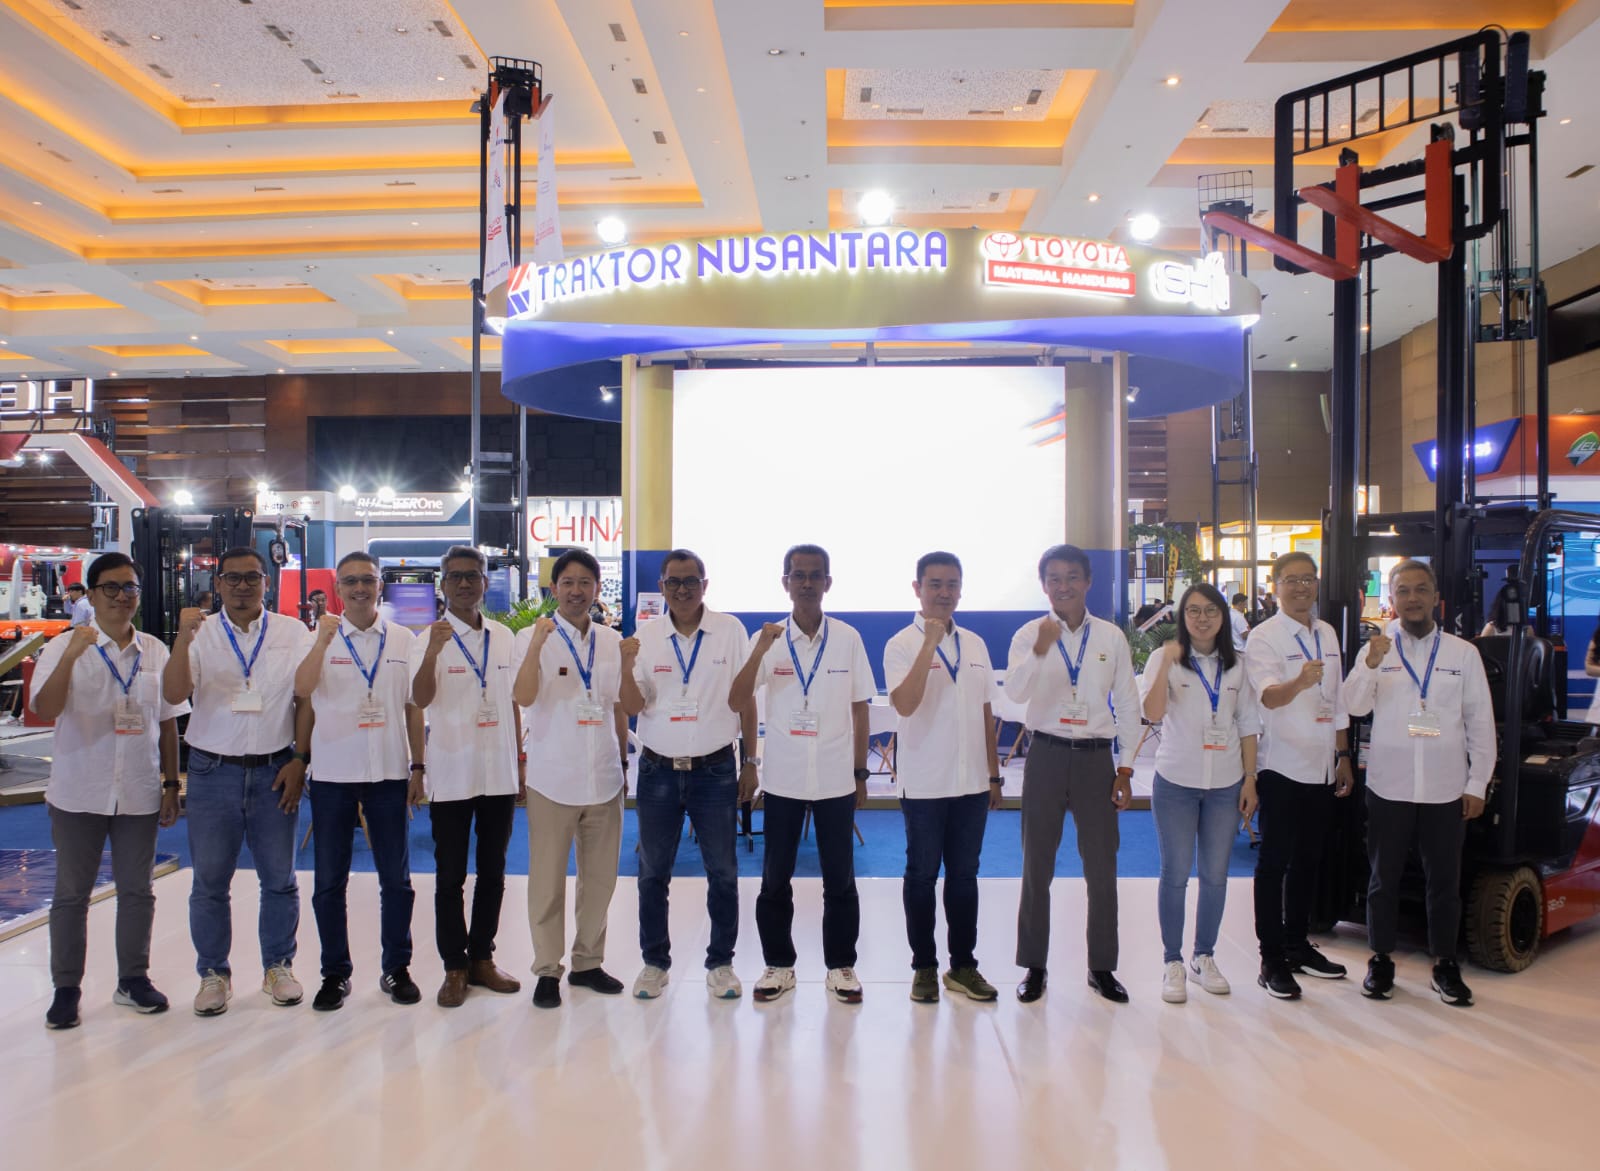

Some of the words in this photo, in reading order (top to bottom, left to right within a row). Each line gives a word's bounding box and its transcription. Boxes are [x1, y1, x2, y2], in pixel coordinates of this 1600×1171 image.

[537, 243, 682, 300] TRAKTOR
[697, 230, 947, 277] NUSANTARA
[1029, 236, 1131, 266] TOYOTA
